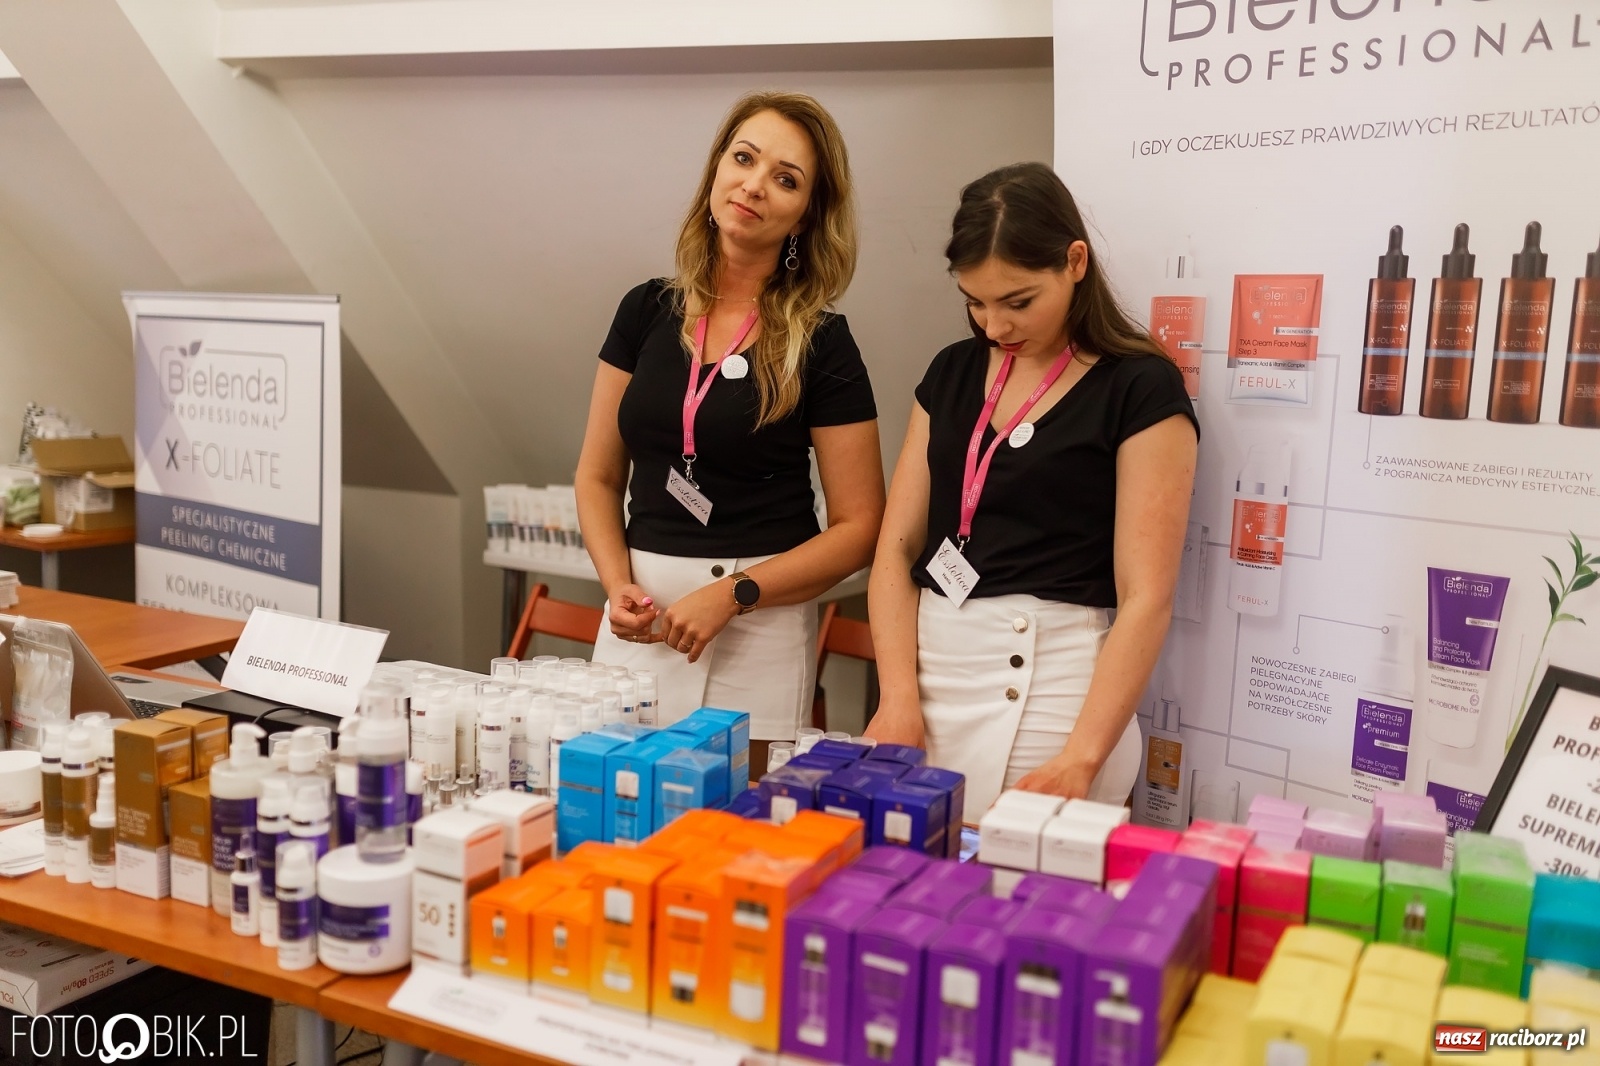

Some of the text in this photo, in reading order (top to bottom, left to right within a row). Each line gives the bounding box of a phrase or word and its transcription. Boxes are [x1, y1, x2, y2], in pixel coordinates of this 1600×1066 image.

[1167, 14, 1591, 91] PROFESSIONAL
[1139, 138, 1172, 157] GDY
[1177, 128, 1295, 153] OCZEKUJESZ
[1301, 116, 1458, 145] PRAWDZIWYCH
[1254, 290, 1303, 301] Belena
[1252, 339, 1272, 347] Cream
[1290, 340, 1308, 348] Mask
[1370, 337, 1404, 345] X-FOLIATE
[1432, 338, 1469, 346] X-FOLIATE
[1501, 340, 1541, 348] X-FOLIATE
[1253, 348, 1258, 356] 3
[168, 359, 279, 405] Bielenda
[1239, 375, 1297, 390] FERUL-X
[168, 402, 279, 430] PROFESSIONAL
[164, 437, 281, 490] X-FOLIATE
[1375, 455, 1470, 472] ZAAWANSOWANE
[1472, 463, 1518, 476] ZABIEGI
[1527, 468, 1593, 482] REZULTATY
[1374, 468, 1381, 476] Z
[1383, 468, 1453, 484] POGRANICZA
[1456, 475, 1519, 489] MEDYCYNY
[172, 504, 276, 544] SPECJALISTYCZNE
[161, 526, 287, 572] PEELINGI CHEMICZNE
[1446, 579, 1490, 593] Bielenda
[1446, 588, 1489, 598] PROFESIONAL
[1237, 594, 1269, 606] FERUL-X
[1433, 637, 1460, 649] Balancing
[1433, 645, 1471, 659] and Protecting
[1251, 655, 1357, 684] NOWOCZESNE ZABIEGI
[1450, 655, 1465, 664] Face
[1465, 657, 1480, 666] Mask
[246, 655, 349, 687] BIELENDA PROFESSIONAL
[1250, 666, 1323, 689] PIELĘGNACYJNE
[1249, 678, 1330, 703] ODPOWIADAJĄCE
[1248, 689, 1333, 715] NA WSPÓŁCZESNE
[1247, 700, 1328, 725] POTRZEBY SKÓRY
[1363, 706, 1403, 723] Bielenda
[1367, 725, 1401, 738] premium
[419, 903, 440, 926] 50
[89, 966, 115, 984] SPEED
